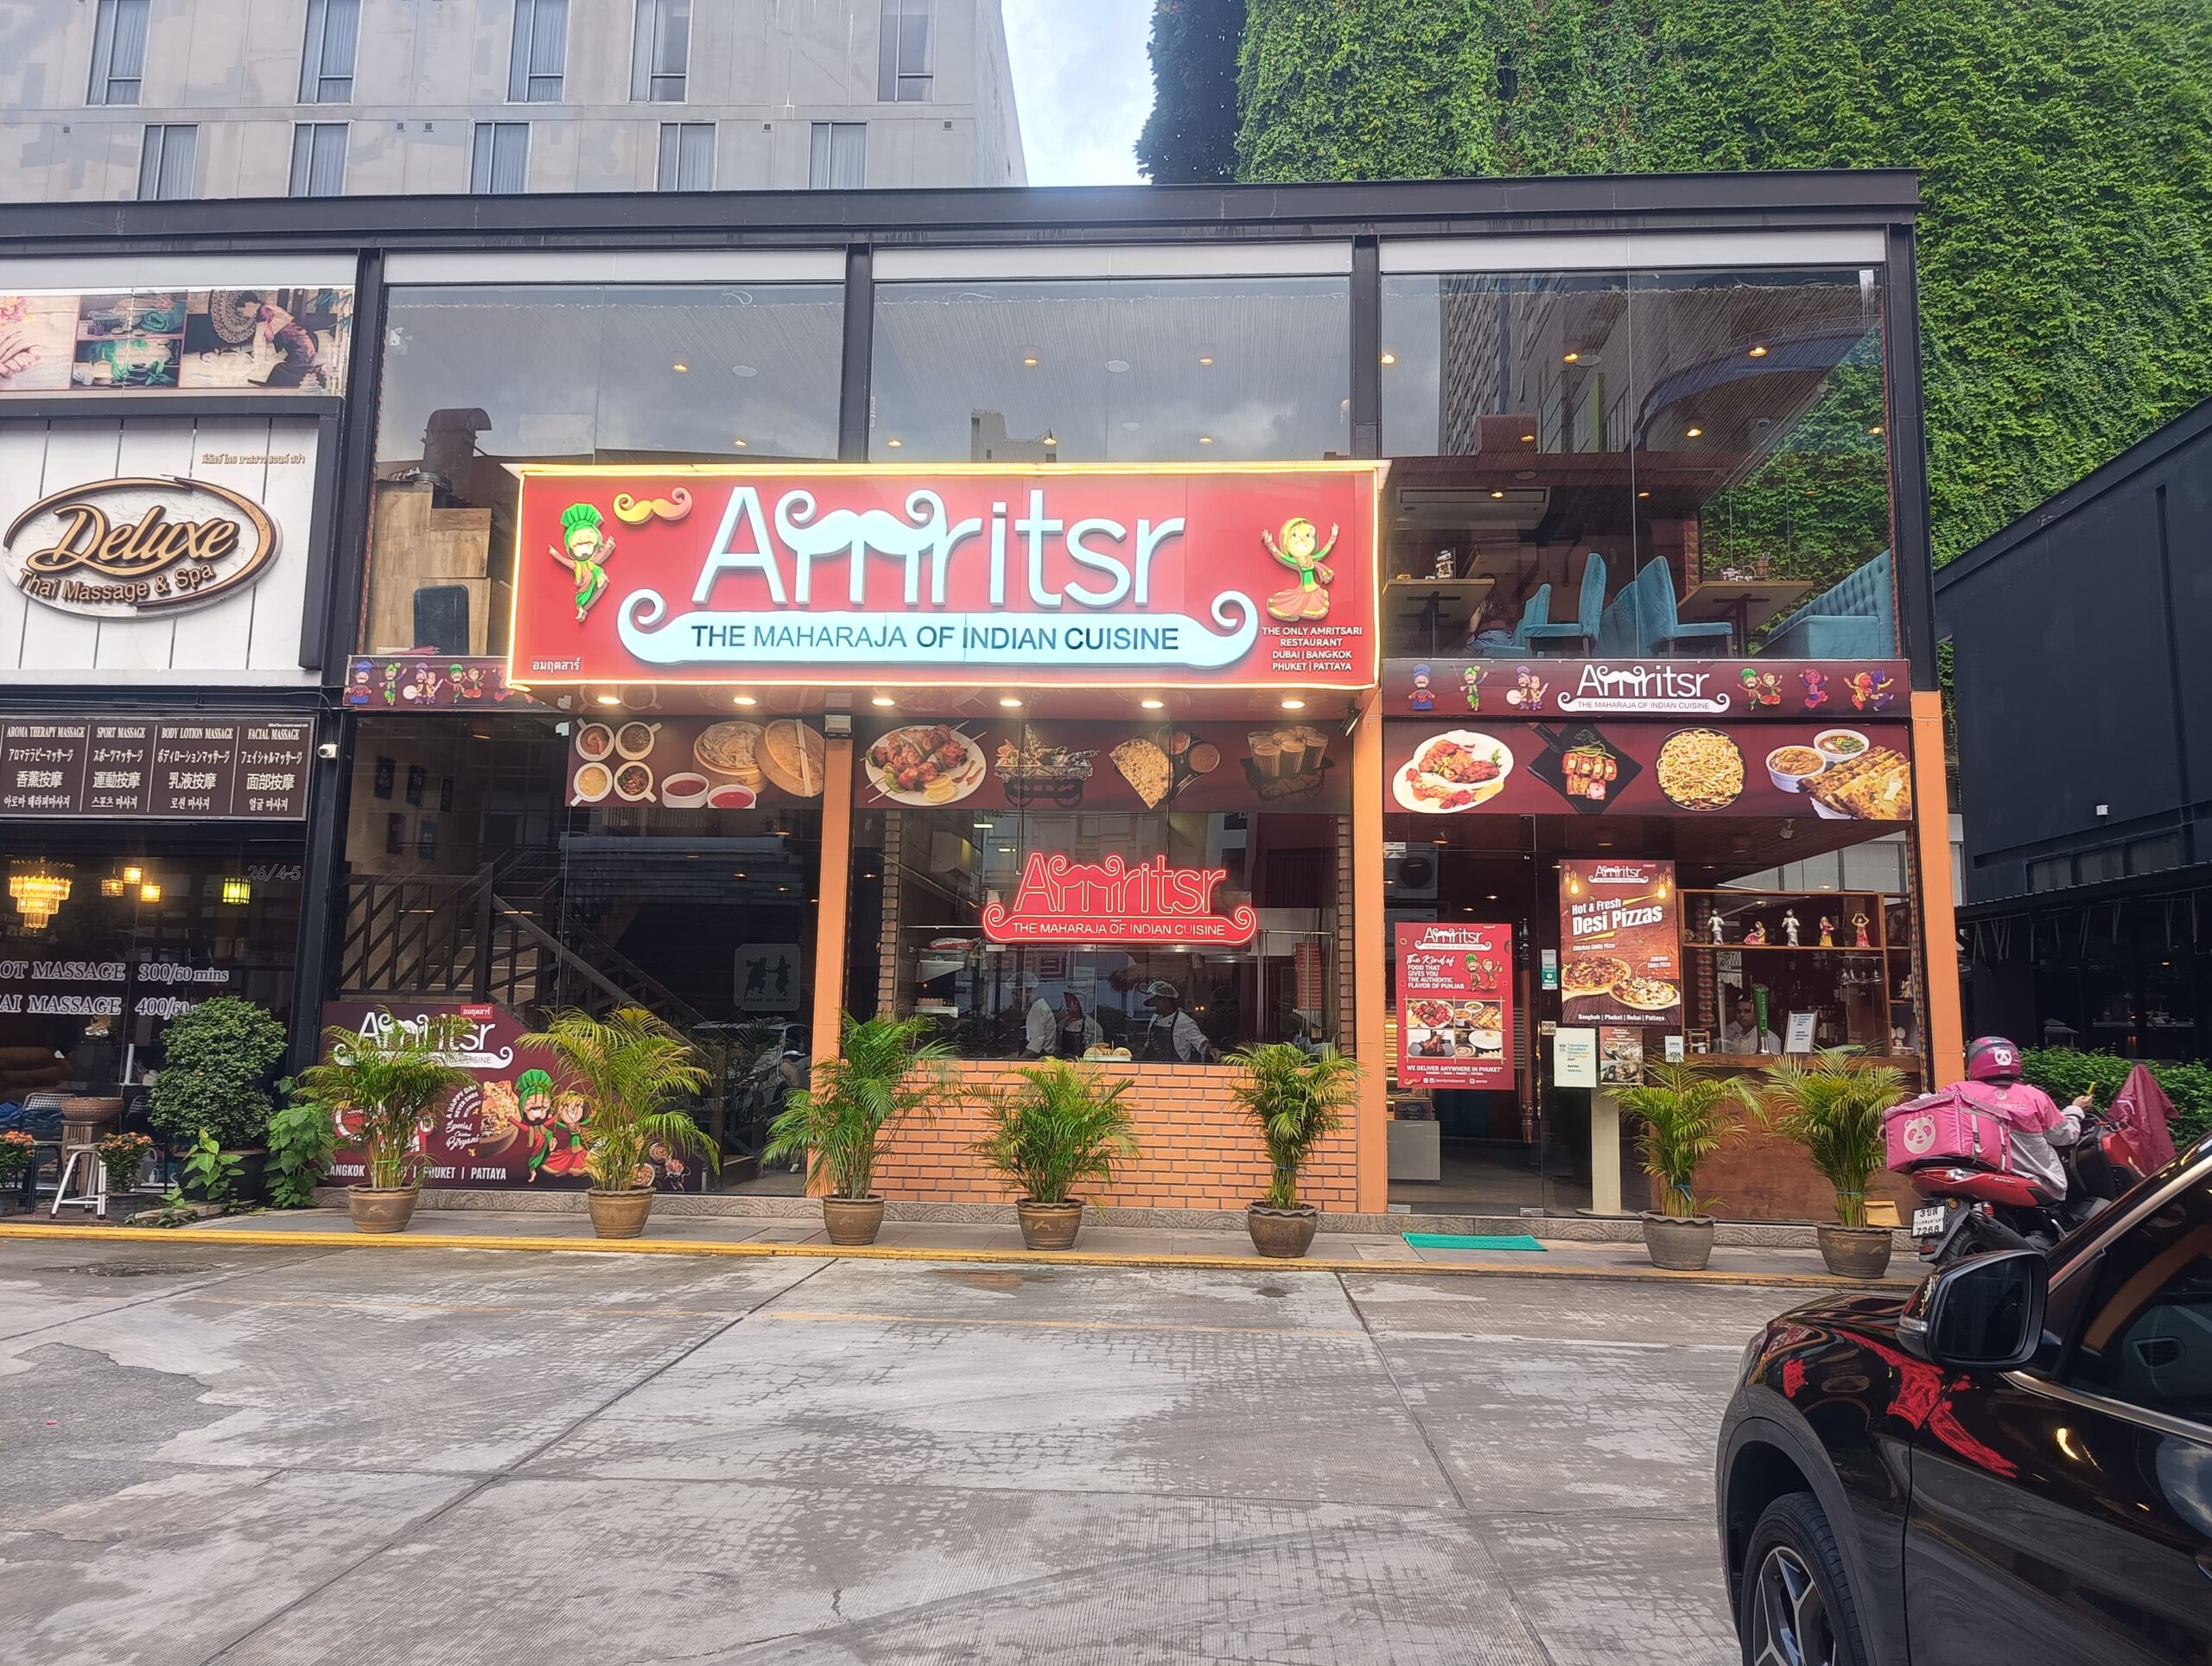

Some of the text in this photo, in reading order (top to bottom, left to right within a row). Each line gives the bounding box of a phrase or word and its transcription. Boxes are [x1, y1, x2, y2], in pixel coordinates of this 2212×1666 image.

[26, 503, 240, 579] Deluxe
[691, 486, 1185, 607] Amritsr
[17, 564, 214, 602] Thai Massage & Spa
[691, 626, 1179, 651] THE MAHARAJA OF INDIAN CUISINE
[1262, 626, 1363, 635] THE ONLY AMRITSARI
[1272, 651, 1352, 659] DUBAI BANGKOK
[1577, 664, 1710, 697] Amritsr
[6, 727, 86, 738] AROMA THERAPY MASSAGE
[96, 727, 146, 739] SPORT MASSAGE
[161, 728, 233, 740] BODY LOTION MASSAGE
[247, 728, 300, 741] FACIAL MASSAGE
[93, 748, 143, 764] スポーツマッサージ
[92, 771, 142, 789] 運動按摩
[168, 773, 218, 790] 乳液按摩
[246, 773, 296, 791] 面部按摩
[4, 795, 25, 809] 아로마
[91, 796, 138, 809] 스포츠 마사지
[170, 797, 211, 811] 로션 마사지
[249, 798, 289, 811] 얼굴 마사지
[247, 864, 301, 881] 26/4-5
[1595, 865, 1642, 878] Amritsr
[1014, 852, 1227, 915] Amritsr
[1572, 898, 1621, 915] Hot & Fresh
[1013, 922, 1225, 936] THE MAHARAJA OF INDIAN CUISINE
[1573, 906, 1662, 936] Desi Pizzas
[1423, 926, 1483, 944] Amritsr
[1407, 953, 1421, 964] The
[1446, 955, 1455, 967] of
[32, 961, 126, 981] MASSAGE
[138, 963, 193, 984] 300/60
[193, 968, 229, 982] mins
[0, 995, 22, 1013] AI
[28, 995, 122, 1015] MASSAGE
[359, 1012, 496, 1051] Amisr
[448, 1091, 464, 1113] HAPPY
[454, 1091, 479, 1118] NEVER ENDS
[446, 1120, 473, 1133] Special
[446, 1134, 480, 1151] Biryani
[471, 1167, 507, 1180] PATTAYA
[1916, 1225, 1940, 1235] 7268
